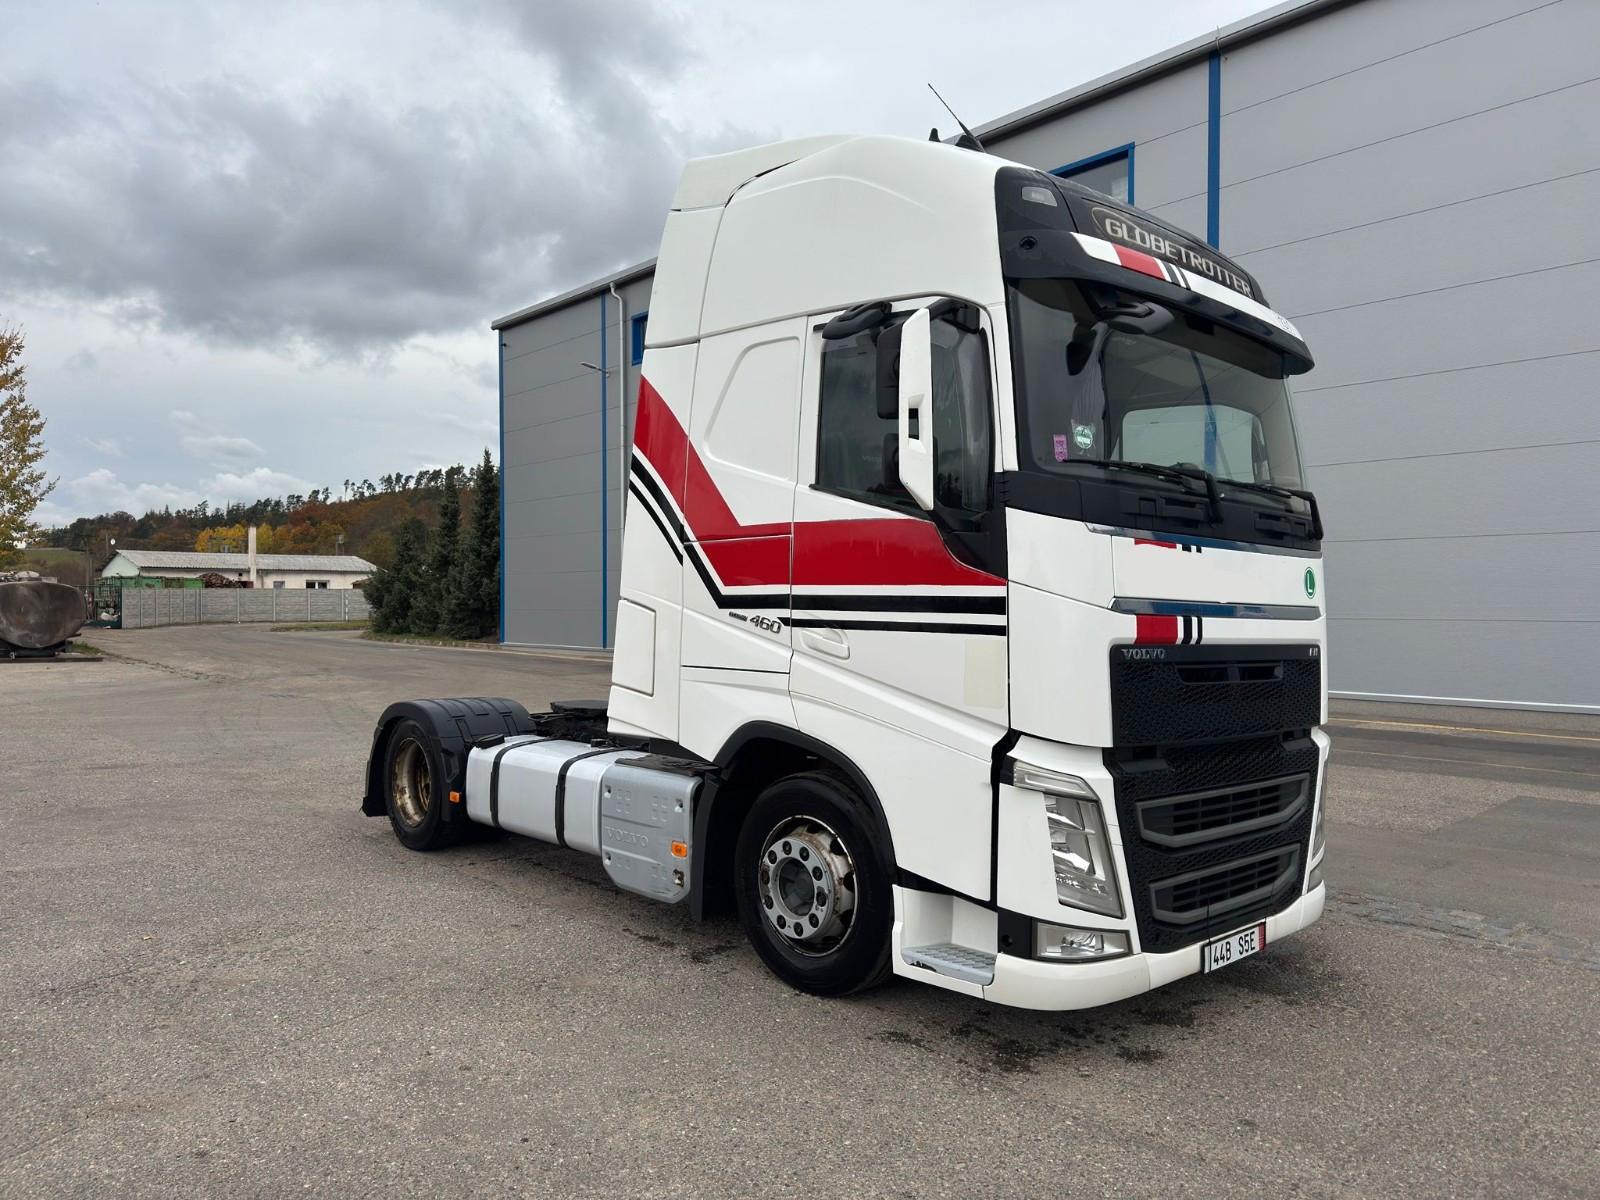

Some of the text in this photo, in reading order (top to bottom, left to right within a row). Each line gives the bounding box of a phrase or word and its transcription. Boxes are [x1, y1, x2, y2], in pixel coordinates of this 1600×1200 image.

[1105, 218, 1252, 298] GLOBETROTTER
[749, 615, 781, 634] 460
[1121, 648, 1165, 660] VOLVO
[605, 825, 649, 848] VOLVO
[1213, 941, 1231, 965] 44B
[1238, 931, 1255, 955] S5E
